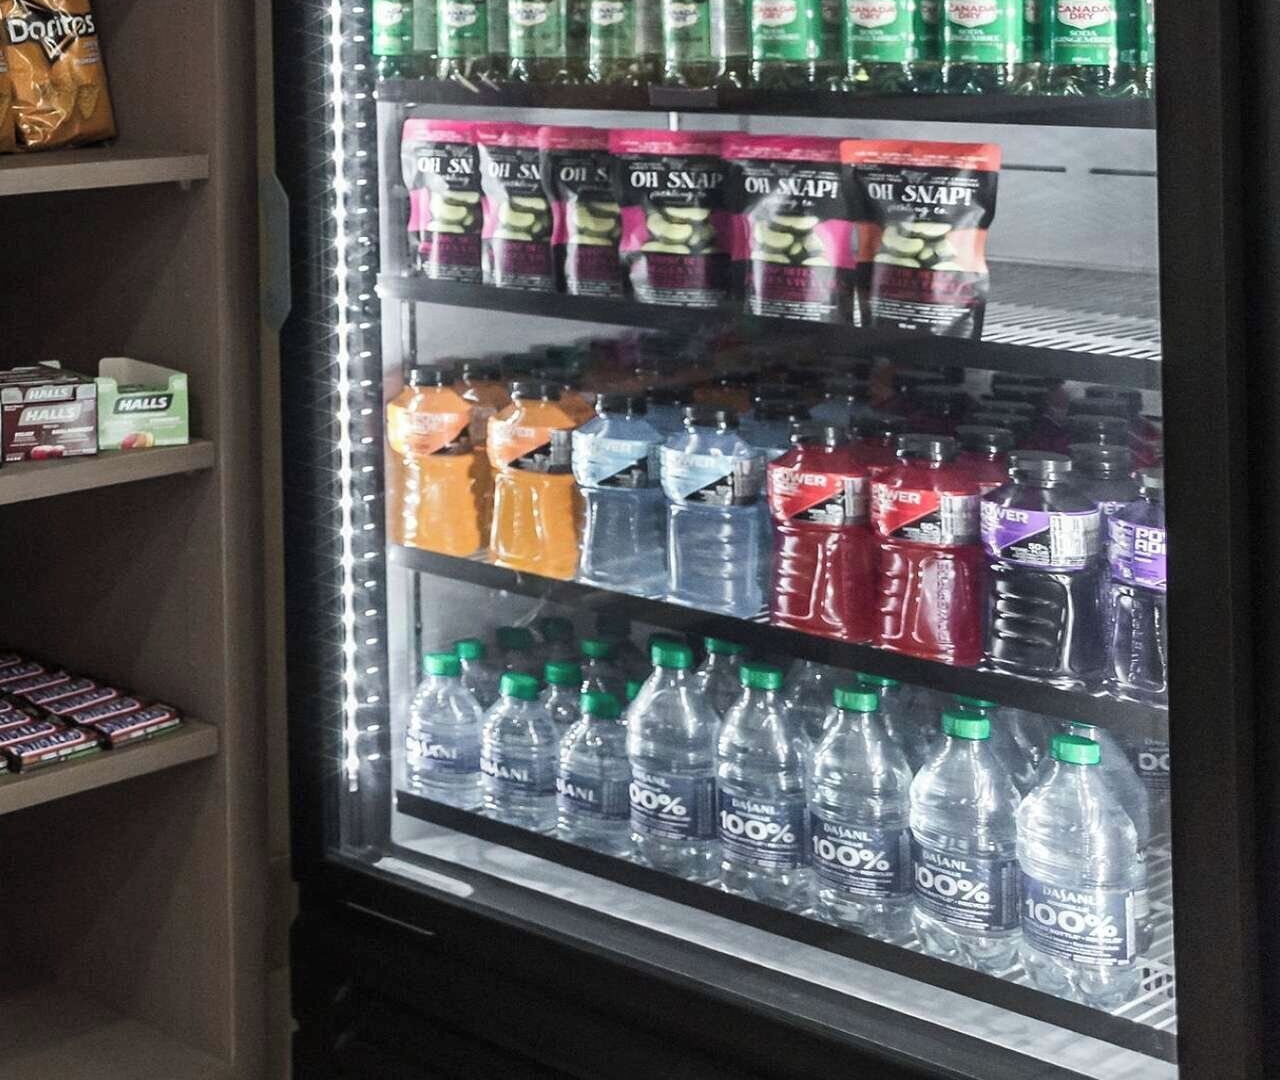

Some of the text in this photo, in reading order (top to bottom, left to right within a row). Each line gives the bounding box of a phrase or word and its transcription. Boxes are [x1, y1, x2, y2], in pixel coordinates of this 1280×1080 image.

[958, 12, 982, 20] DRY
[1058, 4, 1113, 15] CANADA
[1069, 12, 1095, 21] DRY
[9, 11, 96, 44] Doritos
[1068, 29, 1097, 38] SODA
[418, 157, 441, 171] OH
[560, 167, 579, 182] OH
[630, 171, 658, 188] OH
[744, 178, 839, 200] OH SNAP!
[868, 183, 974, 207] OH SNAP!
[28, 387, 69, 400] HALLS
[119, 396, 168, 411] HALLS
[25, 405, 77, 422] HALLS
[730, 797, 780, 816] DASANI
[721, 810, 796, 843] 100%
[823, 822, 873, 842] DASANI
[812, 836, 890, 871] 100%
[922, 850, 973, 873] DASANI
[914, 863, 990, 904] 100%
[1042, 887, 1098, 906] DASANI
[1025, 899, 1119, 938] 100%
